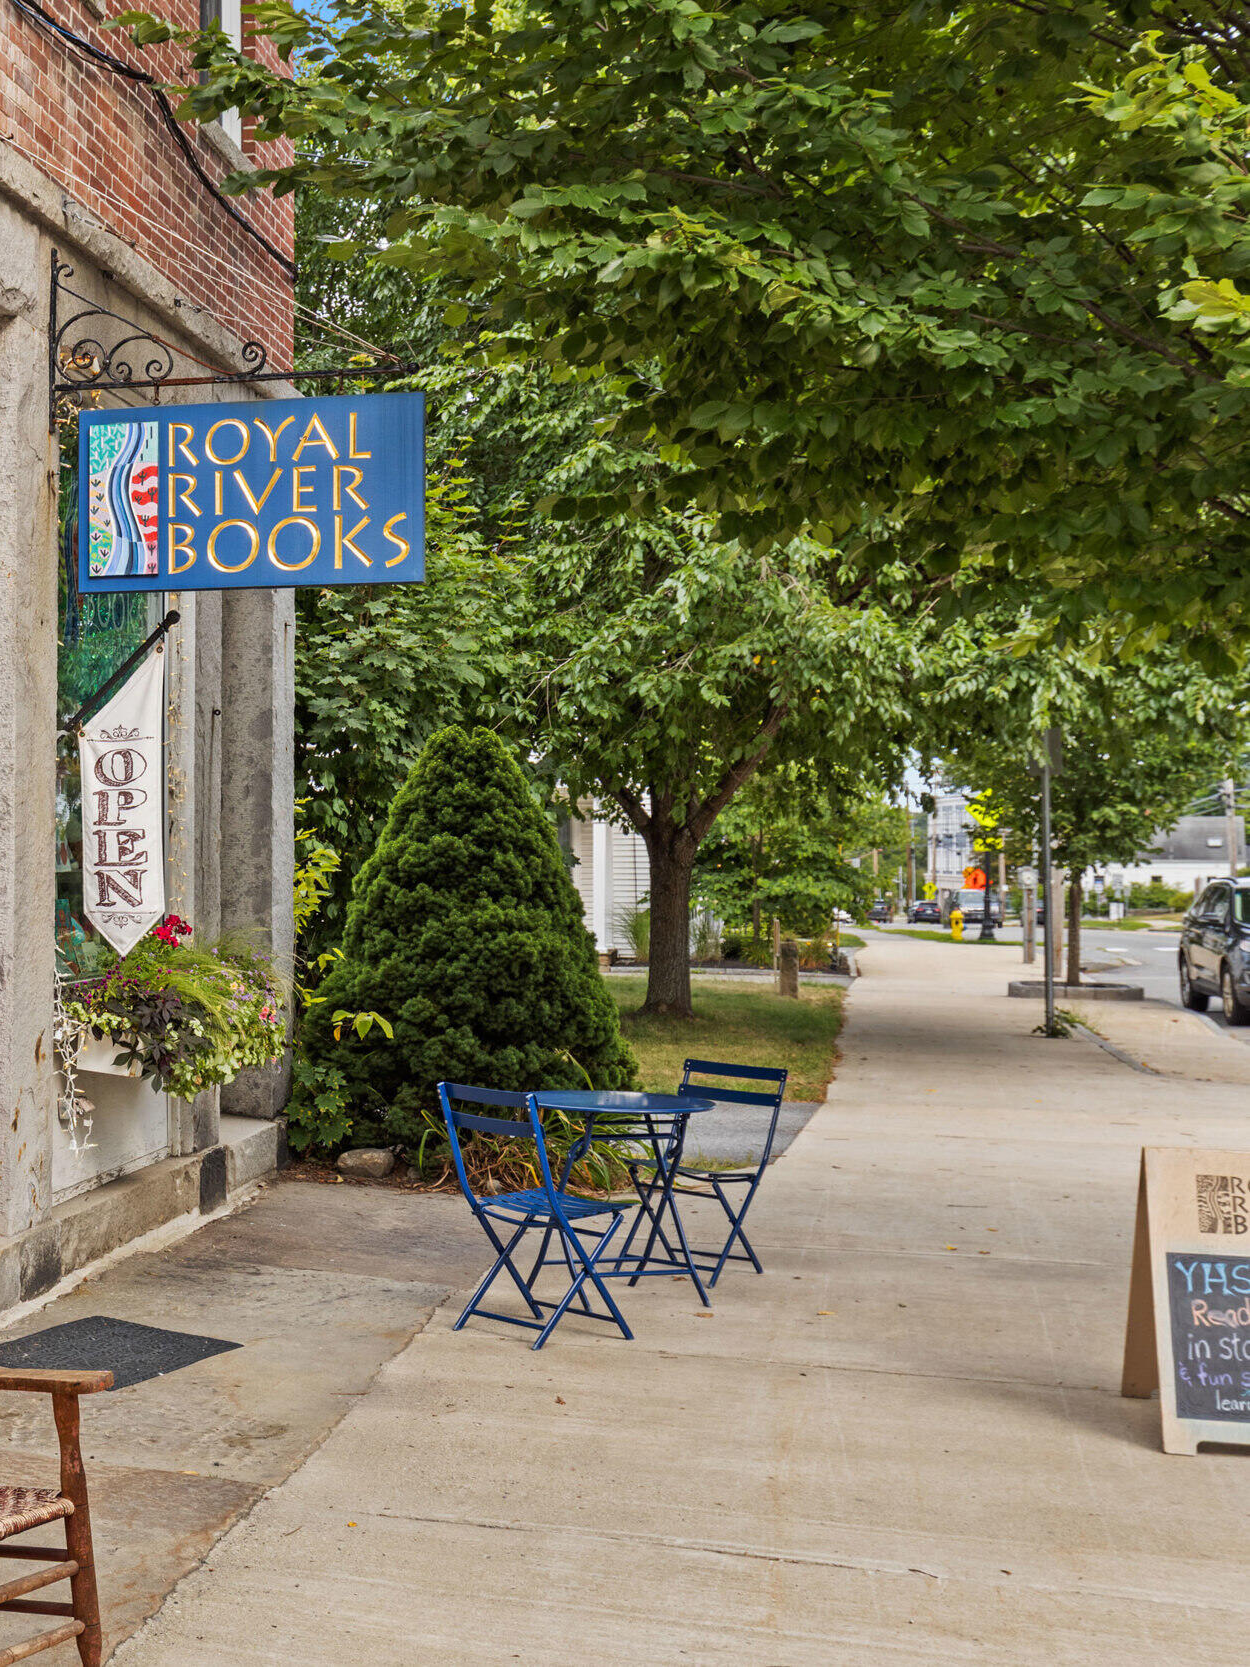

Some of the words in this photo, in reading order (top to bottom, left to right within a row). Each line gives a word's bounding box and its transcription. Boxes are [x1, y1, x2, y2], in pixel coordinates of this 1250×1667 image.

[168, 412, 372, 468] ROYAL
[168, 464, 370, 518] RIVER
[168, 512, 411, 575] BOOKS
[92, 748, 148, 907] OPEN
[1187, 1333, 1211, 1360] in
[1197, 1362, 1233, 1387] fun
